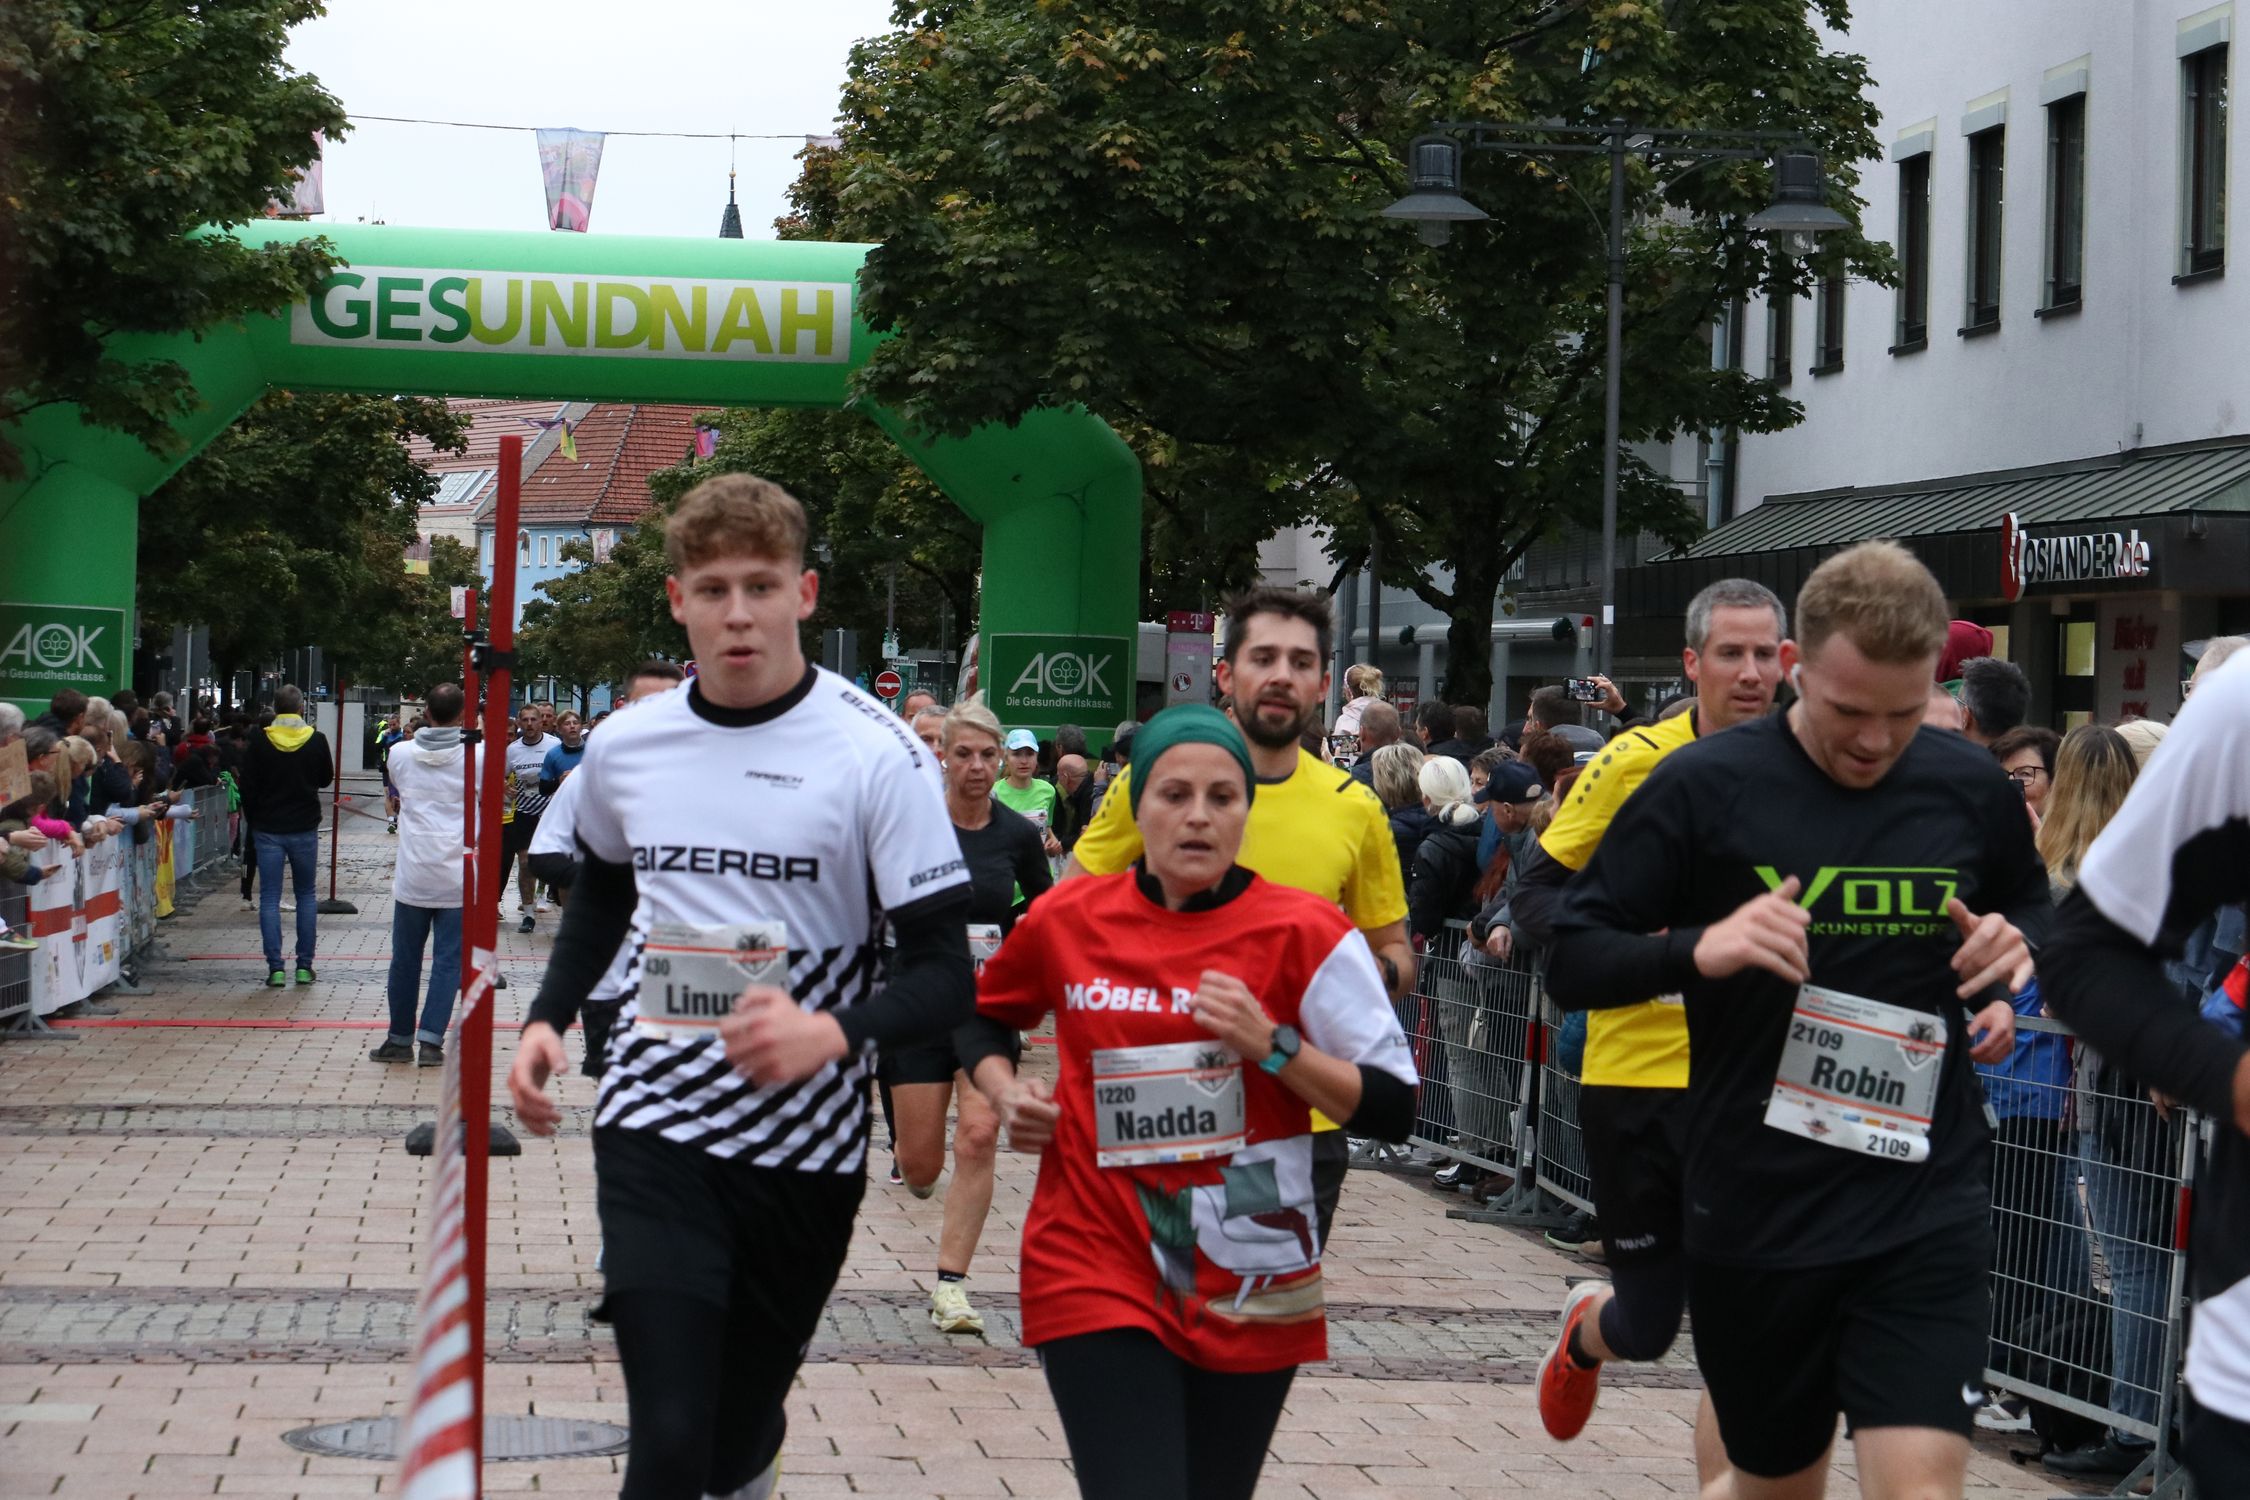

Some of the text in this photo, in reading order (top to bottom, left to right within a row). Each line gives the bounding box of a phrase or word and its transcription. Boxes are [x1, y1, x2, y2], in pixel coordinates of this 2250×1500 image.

[310, 272, 834, 356] GESUNDNAH
[0, 623, 105, 668] AOK
[9, 668, 106, 682] Gesundheitskasse.
[1009, 652, 1112, 696] AOK
[1006, 696, 1114, 710] Die Gesundheitskasse.
[633, 845, 819, 883] BIZERBA
[1753, 866, 1958, 916] VOLZ
[1064, 977, 1201, 1014] MÖBEL R
[1791, 1022, 1844, 1051] 2109
[1097, 1085, 1136, 1105] 1220
[1810, 1054, 1906, 1107] Robin
[1115, 1105, 1217, 1141] Nadda
[1867, 1134, 1911, 1158] 2109
